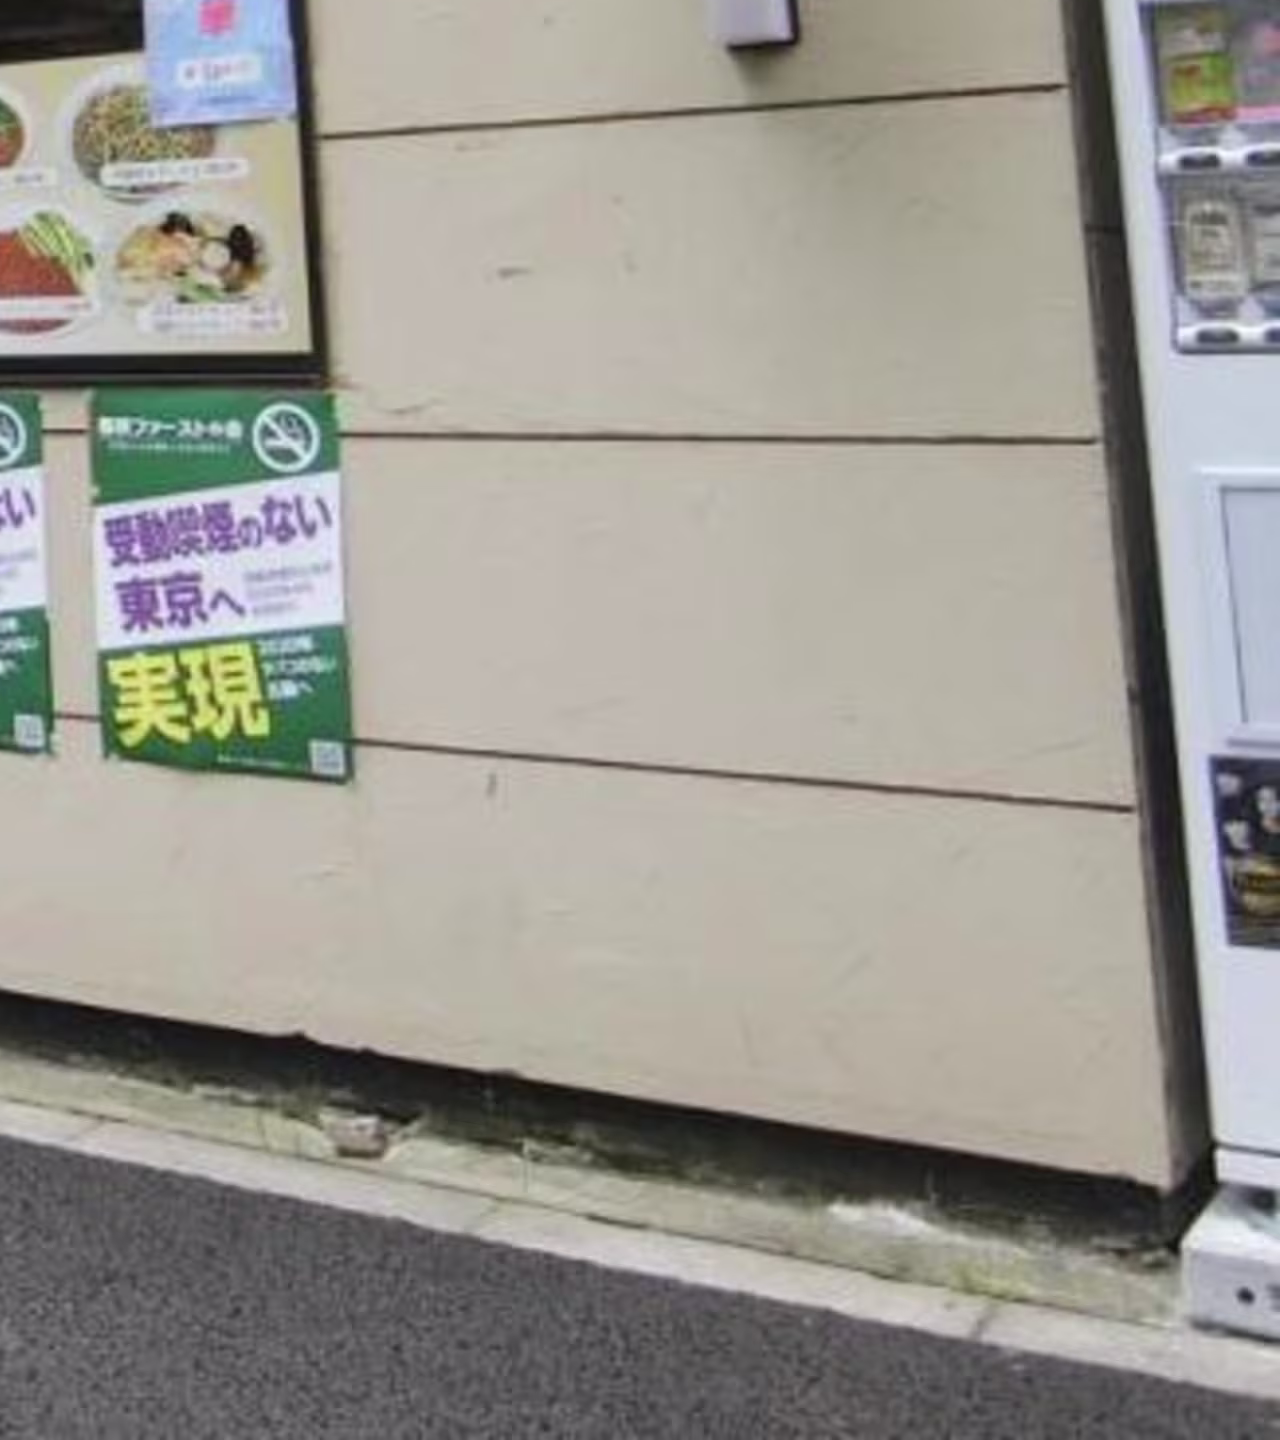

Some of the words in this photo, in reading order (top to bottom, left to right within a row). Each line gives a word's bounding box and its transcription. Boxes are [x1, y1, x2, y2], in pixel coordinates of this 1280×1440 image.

[103, 492, 334, 568] 受動喫煙のない
[114, 572, 246, 633] 東京へ
[106, 640, 272, 749] 実現
